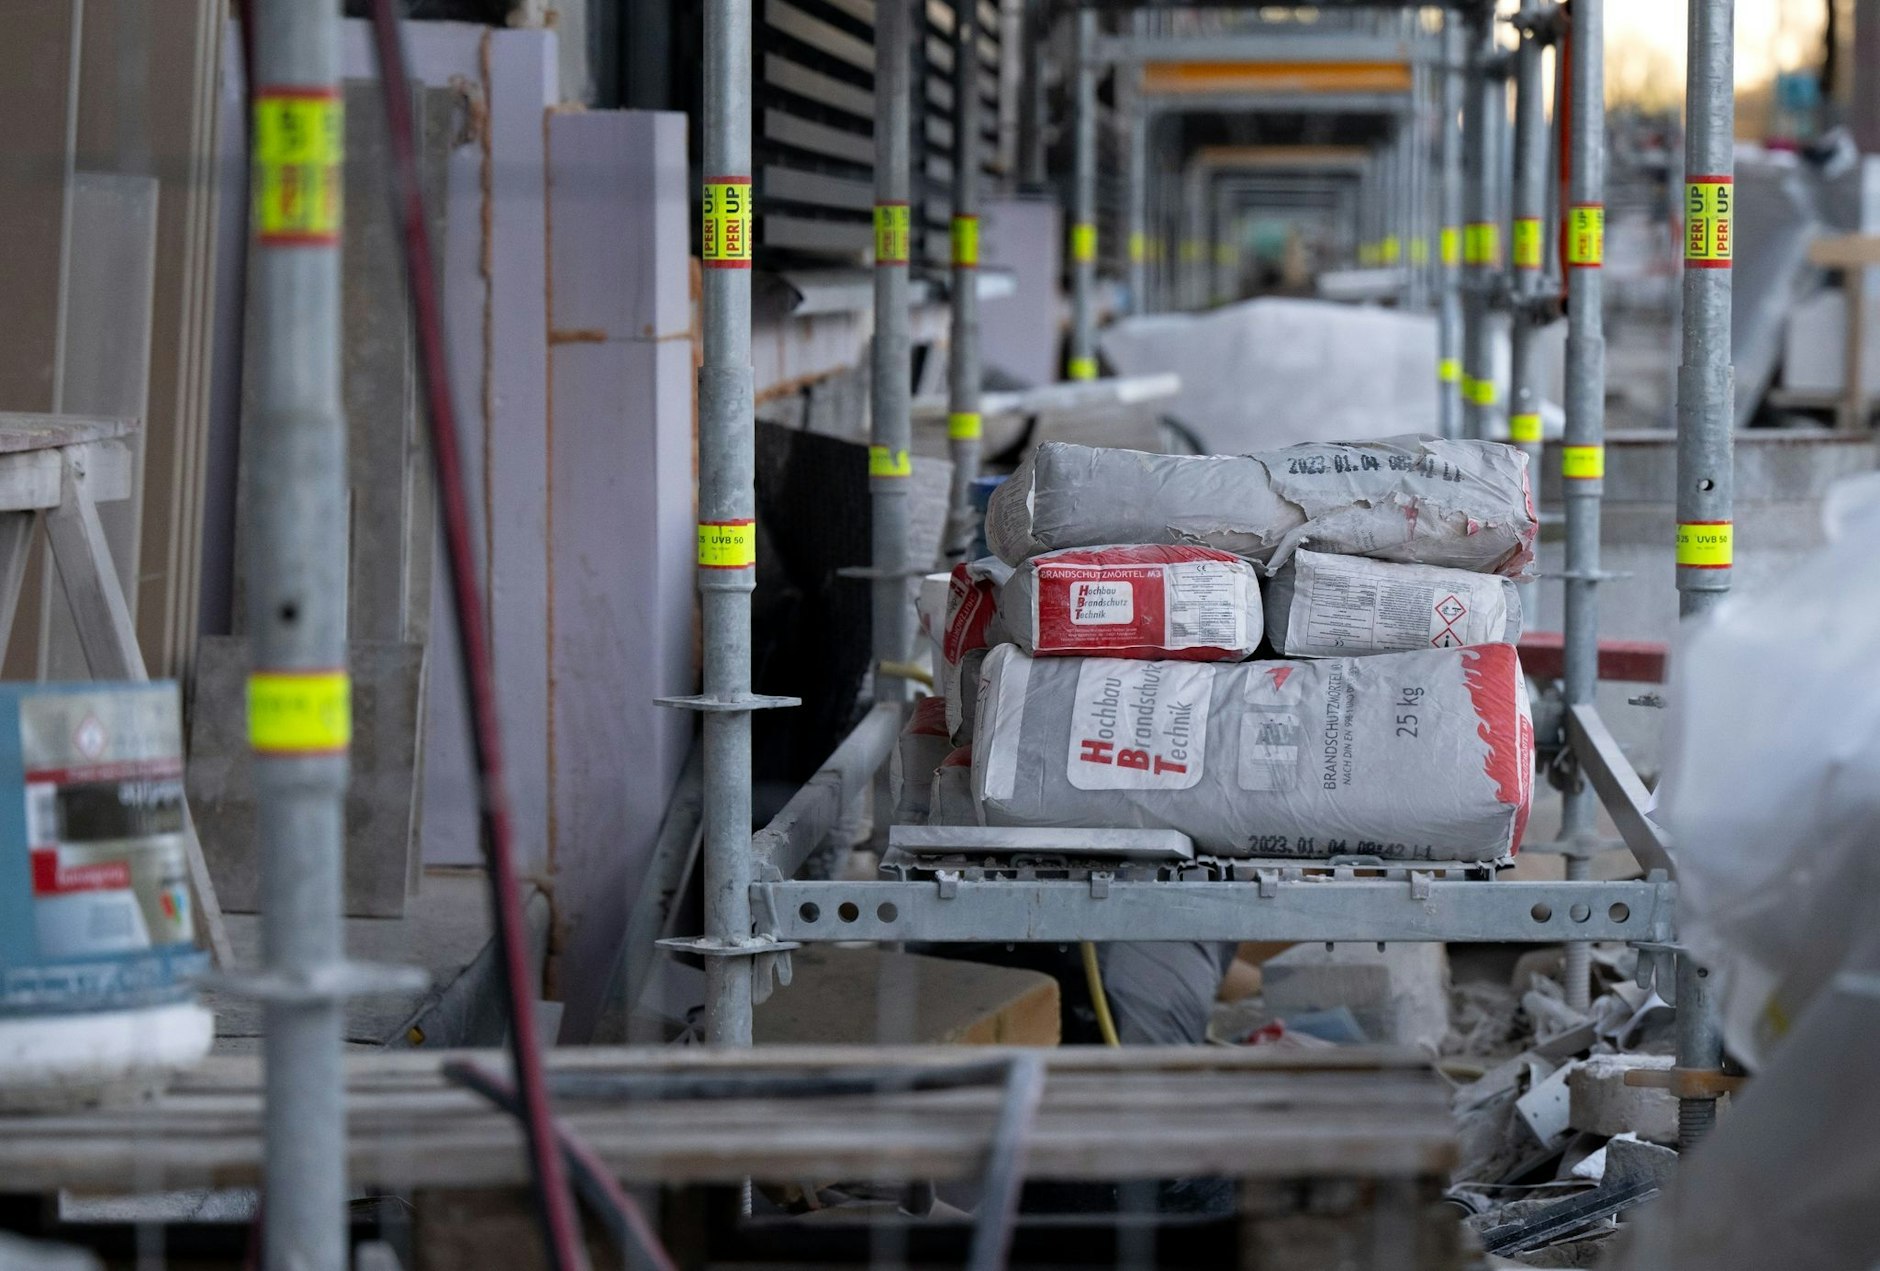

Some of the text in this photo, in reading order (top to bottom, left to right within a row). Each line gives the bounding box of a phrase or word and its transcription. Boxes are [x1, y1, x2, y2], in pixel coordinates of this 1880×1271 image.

[704, 187, 714, 252] PERI UP
[726, 186, 740, 252] PERI UP
[1690, 185, 1704, 251] PERI UP
[1717, 186, 1728, 251] PERI UP
[711, 536, 744, 544] UVB 50
[1696, 535, 1727, 543] UVB 50
[1147, 569, 1161, 578] M3
[1077, 597, 1128, 608] Brandschutz
[1079, 585, 1117, 596] Hochbau
[1075, 609, 1106, 620] Technik
[1080, 677, 1122, 765] Hochbau
[1117, 663, 1163, 771] Brandschutz
[1396, 687, 1425, 738] 25 kg
[1154, 701, 1193, 776] Technik
[1344, 729, 1353, 742] EN
[1343, 743, 1353, 759] DIN
[1343, 760, 1353, 786] NACH
